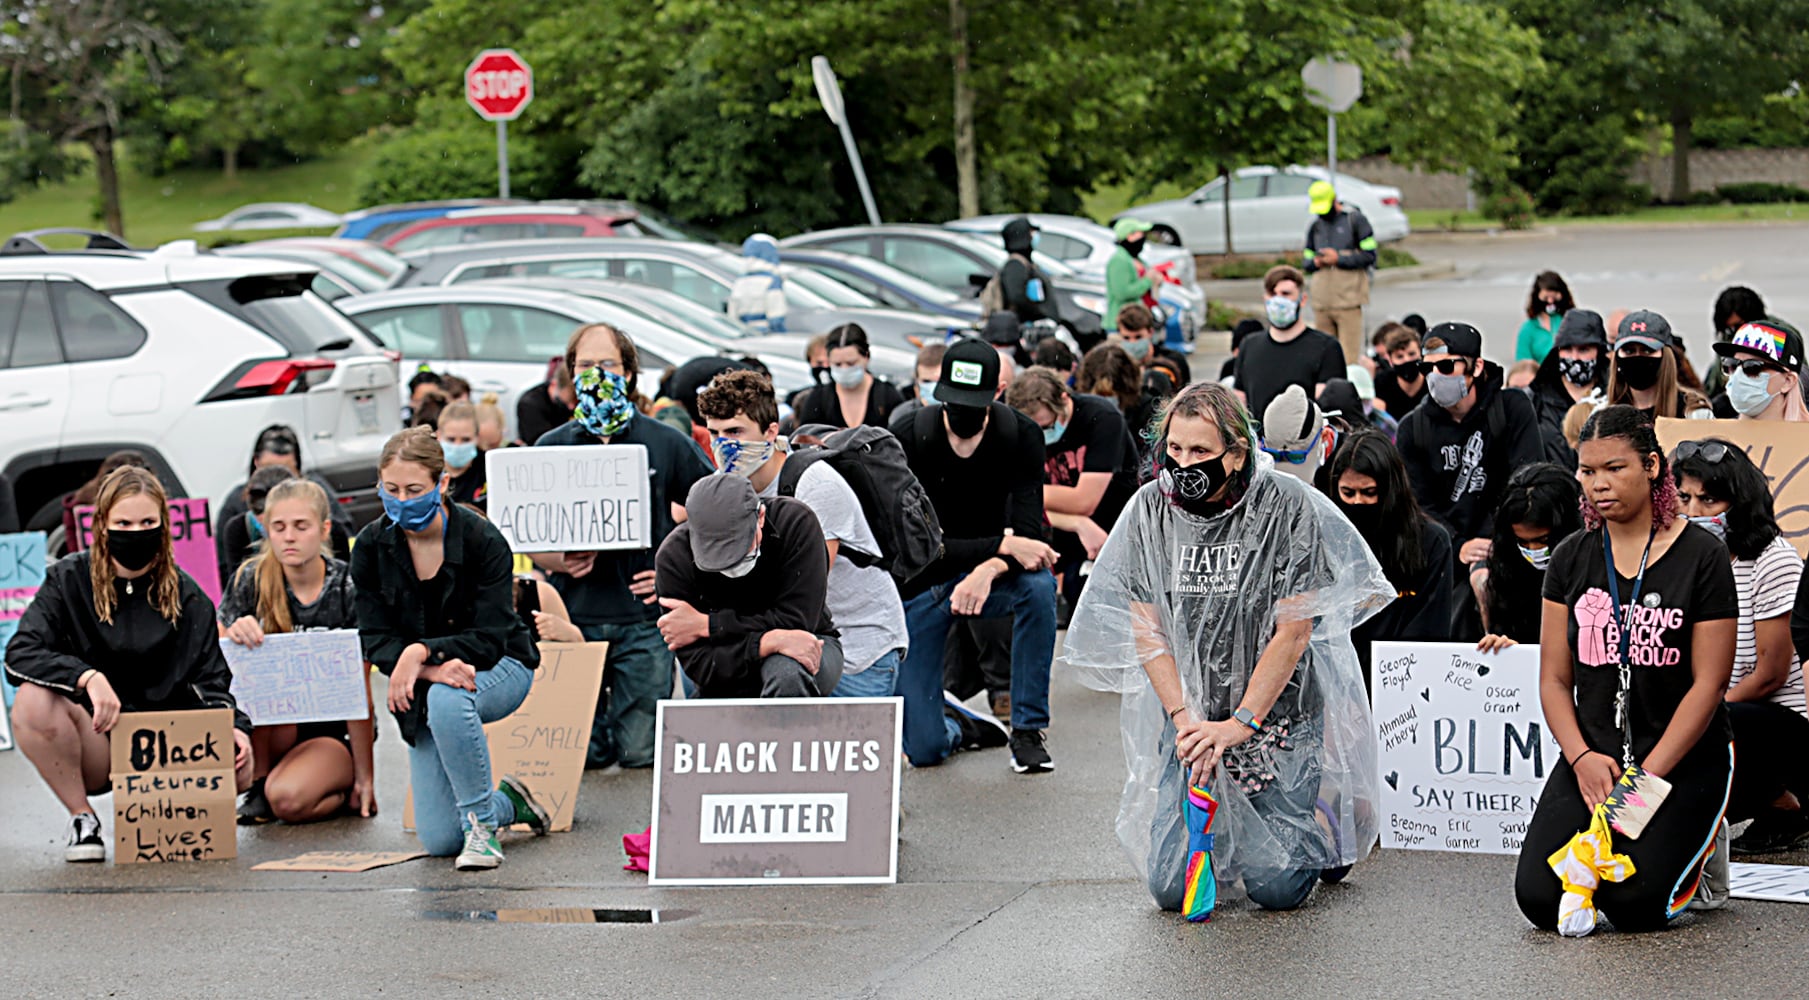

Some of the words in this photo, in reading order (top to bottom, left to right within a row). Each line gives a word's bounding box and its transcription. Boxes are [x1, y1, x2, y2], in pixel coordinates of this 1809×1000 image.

[471, 70, 526, 99] STOP
[507, 462, 556, 491] HOLD
[567, 457, 628, 490] POLICE
[501, 499, 639, 546] ACCOUNTABLE
[1179, 543, 1240, 573] HATE
[1176, 582, 1210, 594] family
[1177, 574, 1190, 582] is
[1197, 574, 1224, 583] not
[1379, 653, 1417, 674] George
[1451, 654, 1480, 672] Tamir
[1382, 668, 1412, 691] Floyd
[1444, 671, 1473, 691] Rice
[1484, 702, 1521, 713] Grant
[1379, 704, 1417, 740] Ahmaud
[508, 725, 584, 750] SMALL
[1385, 722, 1418, 752] Arbery
[1434, 717, 1544, 778] BLM
[130, 728, 220, 771] Black
[673, 741, 778, 774] BLACK
[791, 740, 880, 773] LIVES
[126, 775, 223, 795] Futures
[1412, 785, 1454, 811] SAY
[1462, 791, 1524, 812] THEIR
[125, 798, 208, 823] Children
[712, 803, 835, 834] MATTER
[1391, 813, 1437, 836] Breonna
[1448, 819, 1472, 832] Eric
[136, 827, 212, 849] Lives
[1393, 831, 1425, 847] Taylor
[1445, 837, 1480, 849] Garner
[135, 847, 214, 863] Matter
